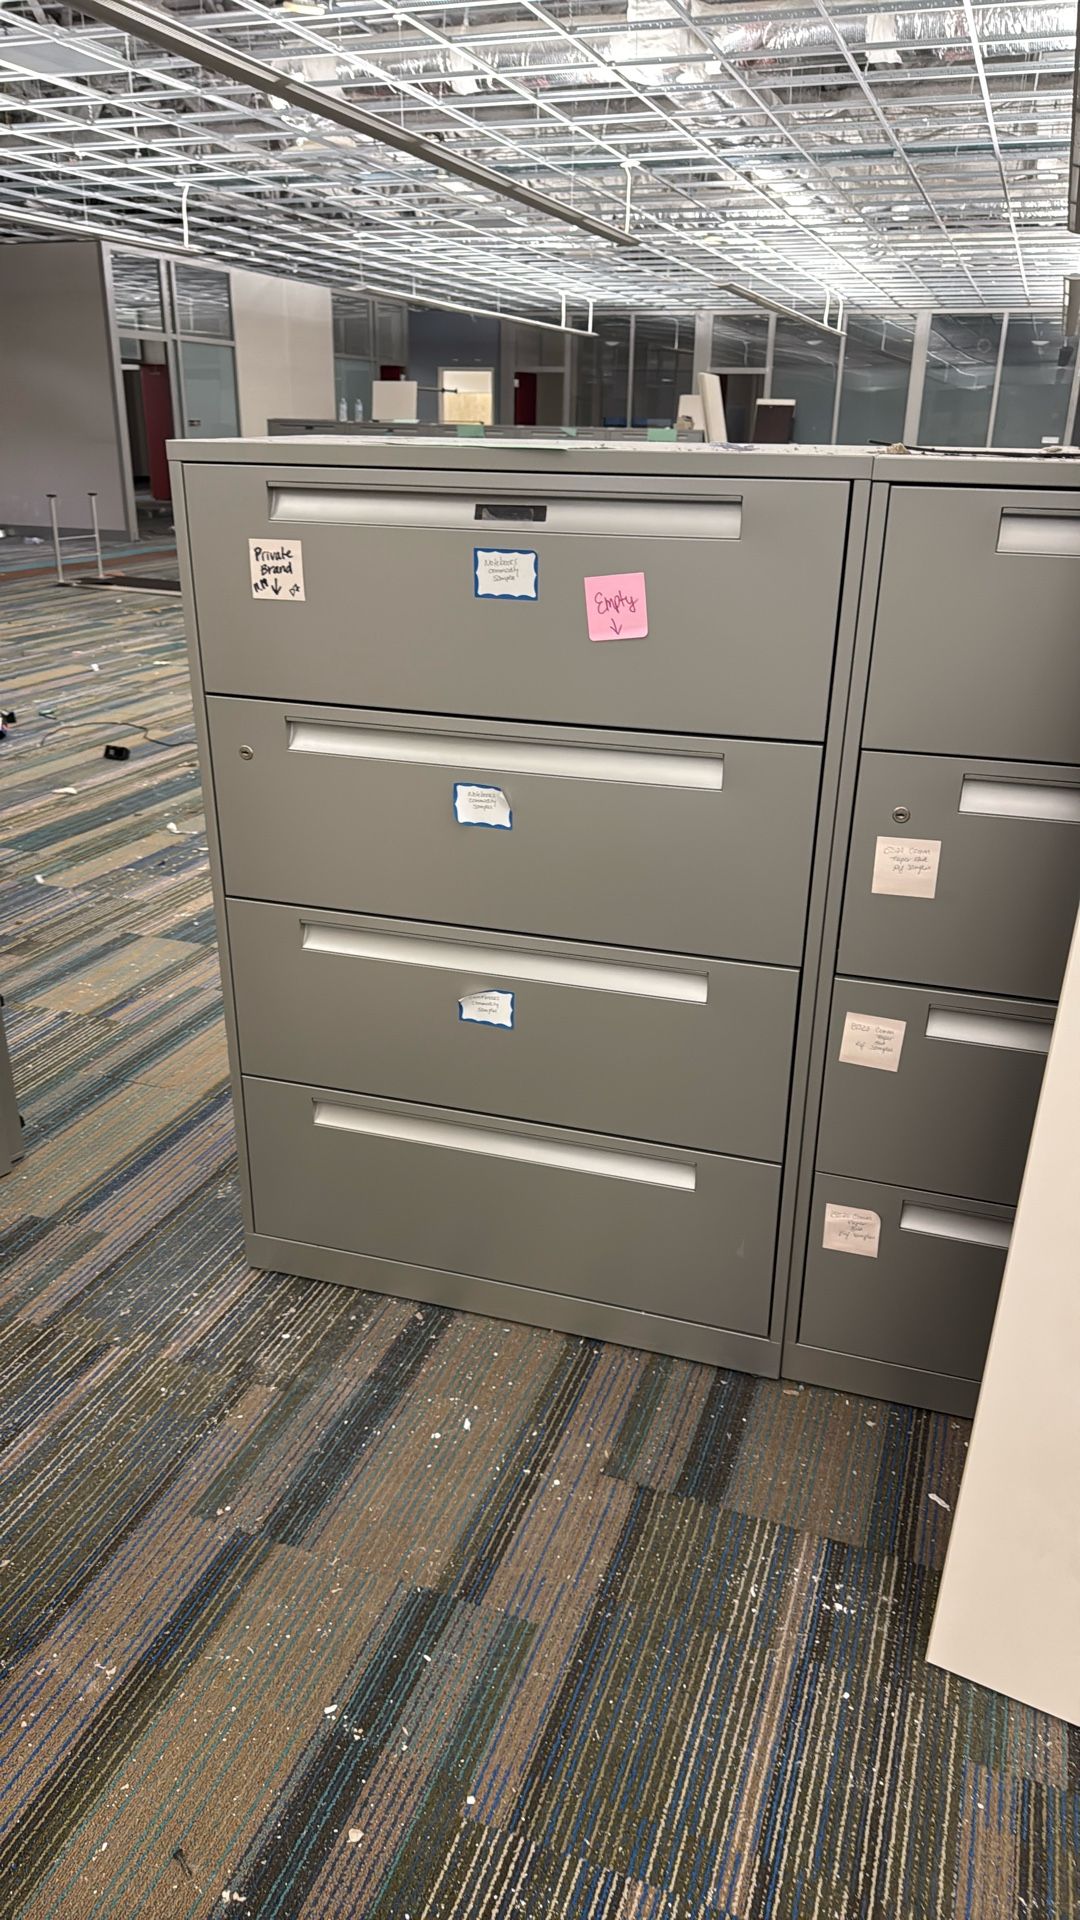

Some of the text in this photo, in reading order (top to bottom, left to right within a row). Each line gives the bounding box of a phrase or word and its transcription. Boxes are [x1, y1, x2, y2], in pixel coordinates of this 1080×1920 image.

[254, 546, 294, 561] Private
[261, 561, 293, 576] Brand
[594, 590, 639, 615] Empty
